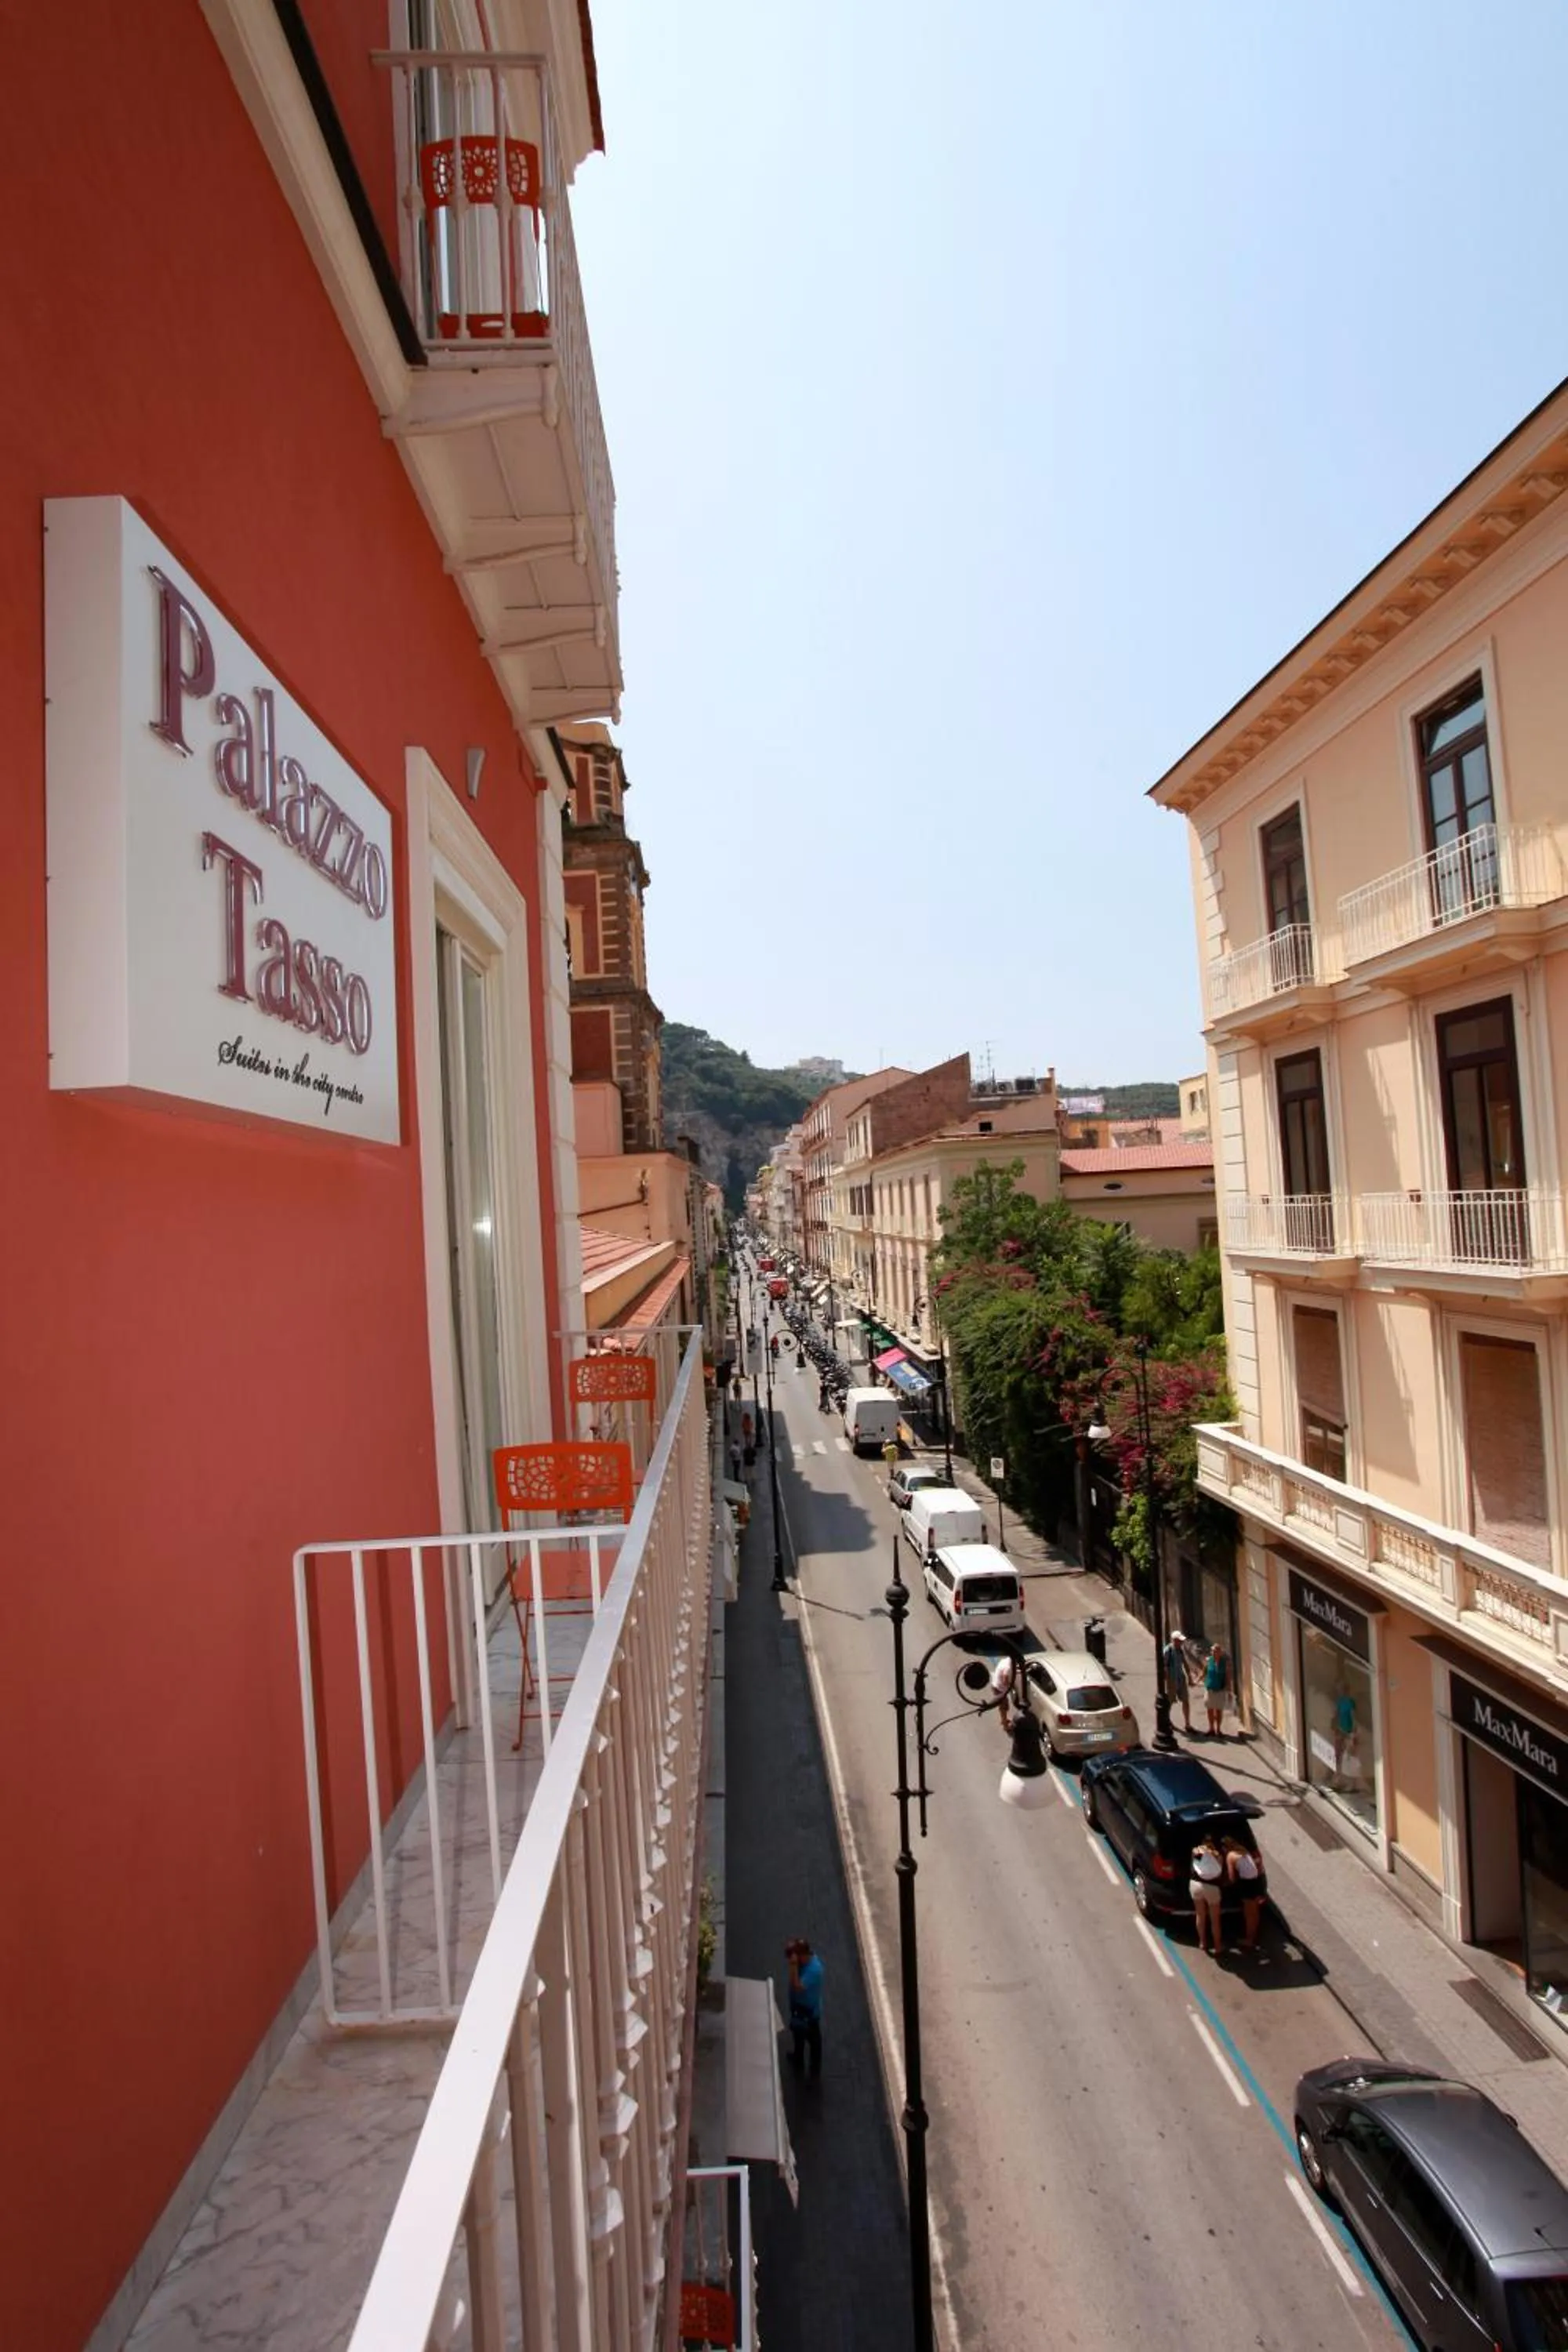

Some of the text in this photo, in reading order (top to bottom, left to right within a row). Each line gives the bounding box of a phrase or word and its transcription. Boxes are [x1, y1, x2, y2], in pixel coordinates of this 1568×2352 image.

[141, 564, 388, 922] Palazzo
[201, 830, 372, 1056] Tasso
[218, 1035, 272, 1076] Suites
[274, 1057, 291, 1082] in
[291, 1052, 311, 1088] the
[312, 1073, 334, 1116] city
[1302, 1587, 1353, 1638] MaxMara
[1472, 1695, 1559, 1777] MaxMara
